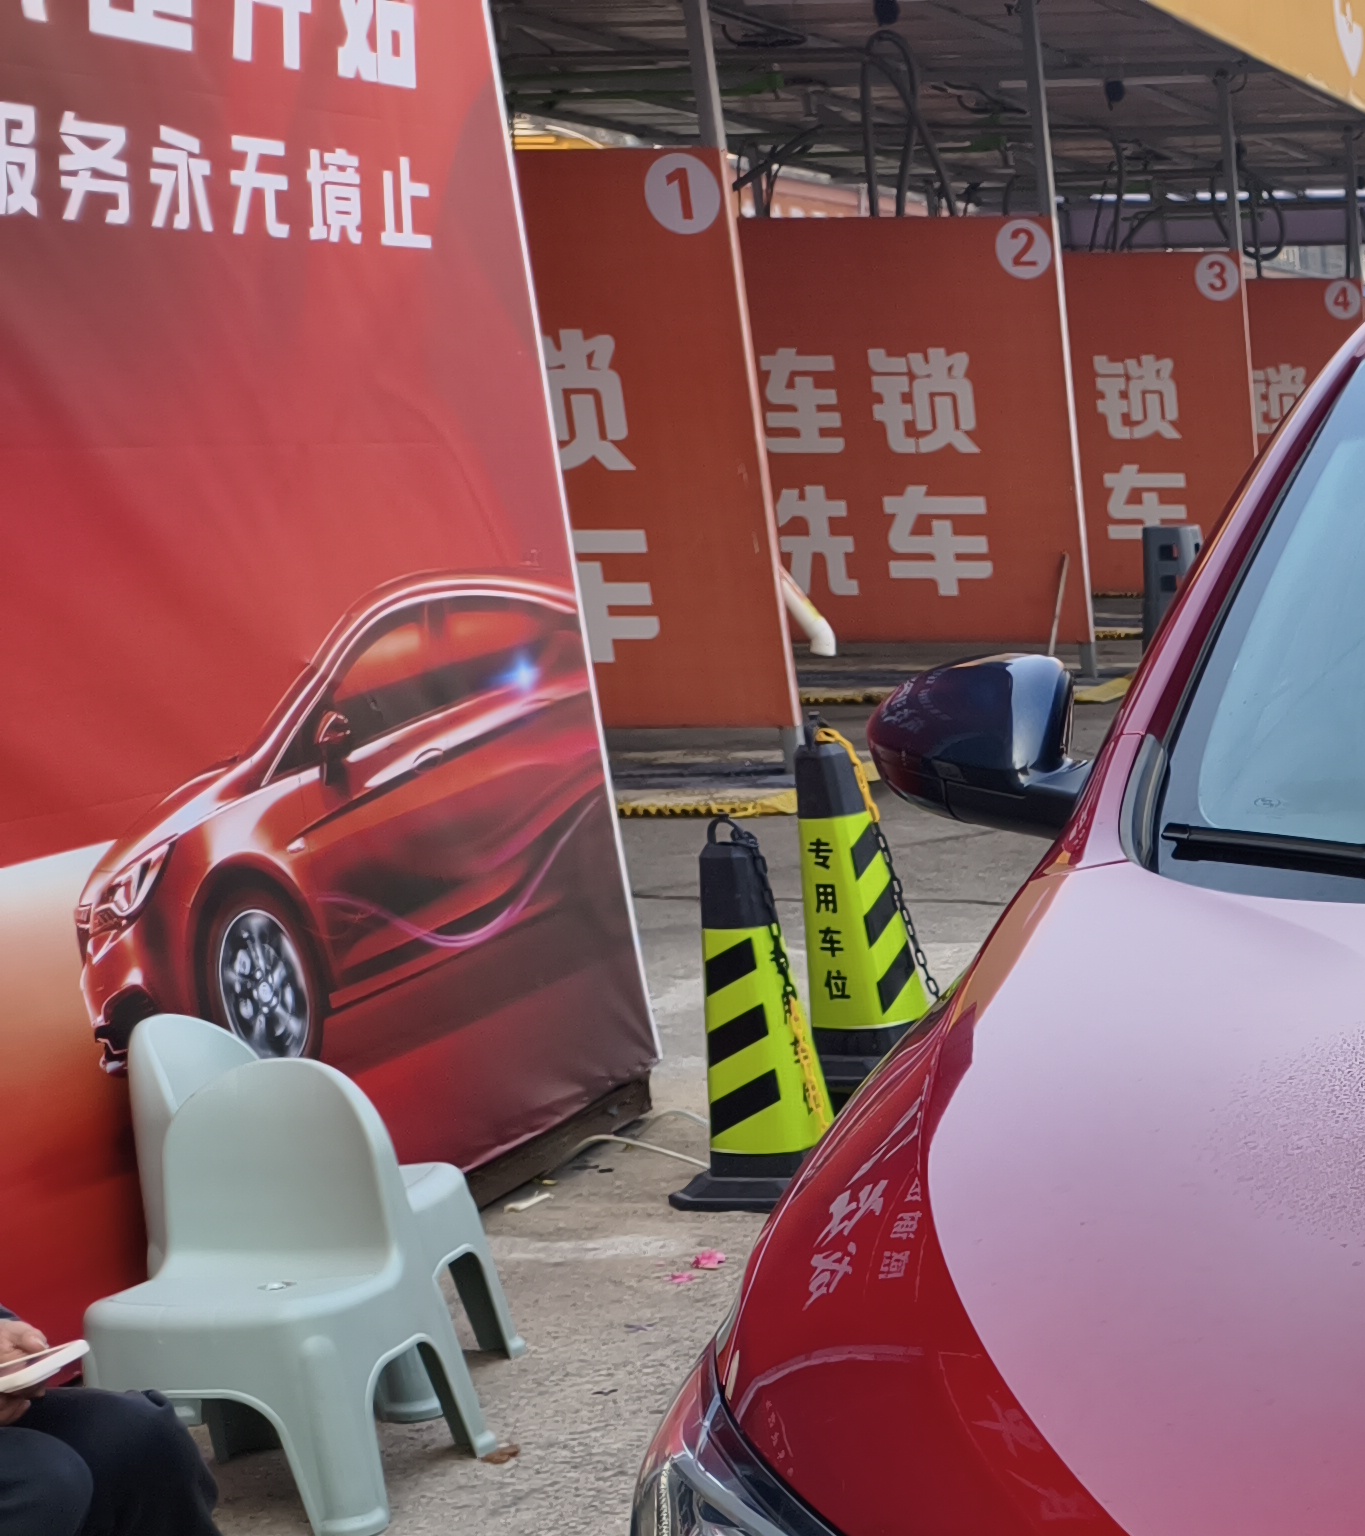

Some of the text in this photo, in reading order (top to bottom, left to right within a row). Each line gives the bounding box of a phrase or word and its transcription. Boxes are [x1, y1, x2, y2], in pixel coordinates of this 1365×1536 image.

[1093, 354, 1182, 439] 锁
[807, 837, 852, 1002] 专用车位
